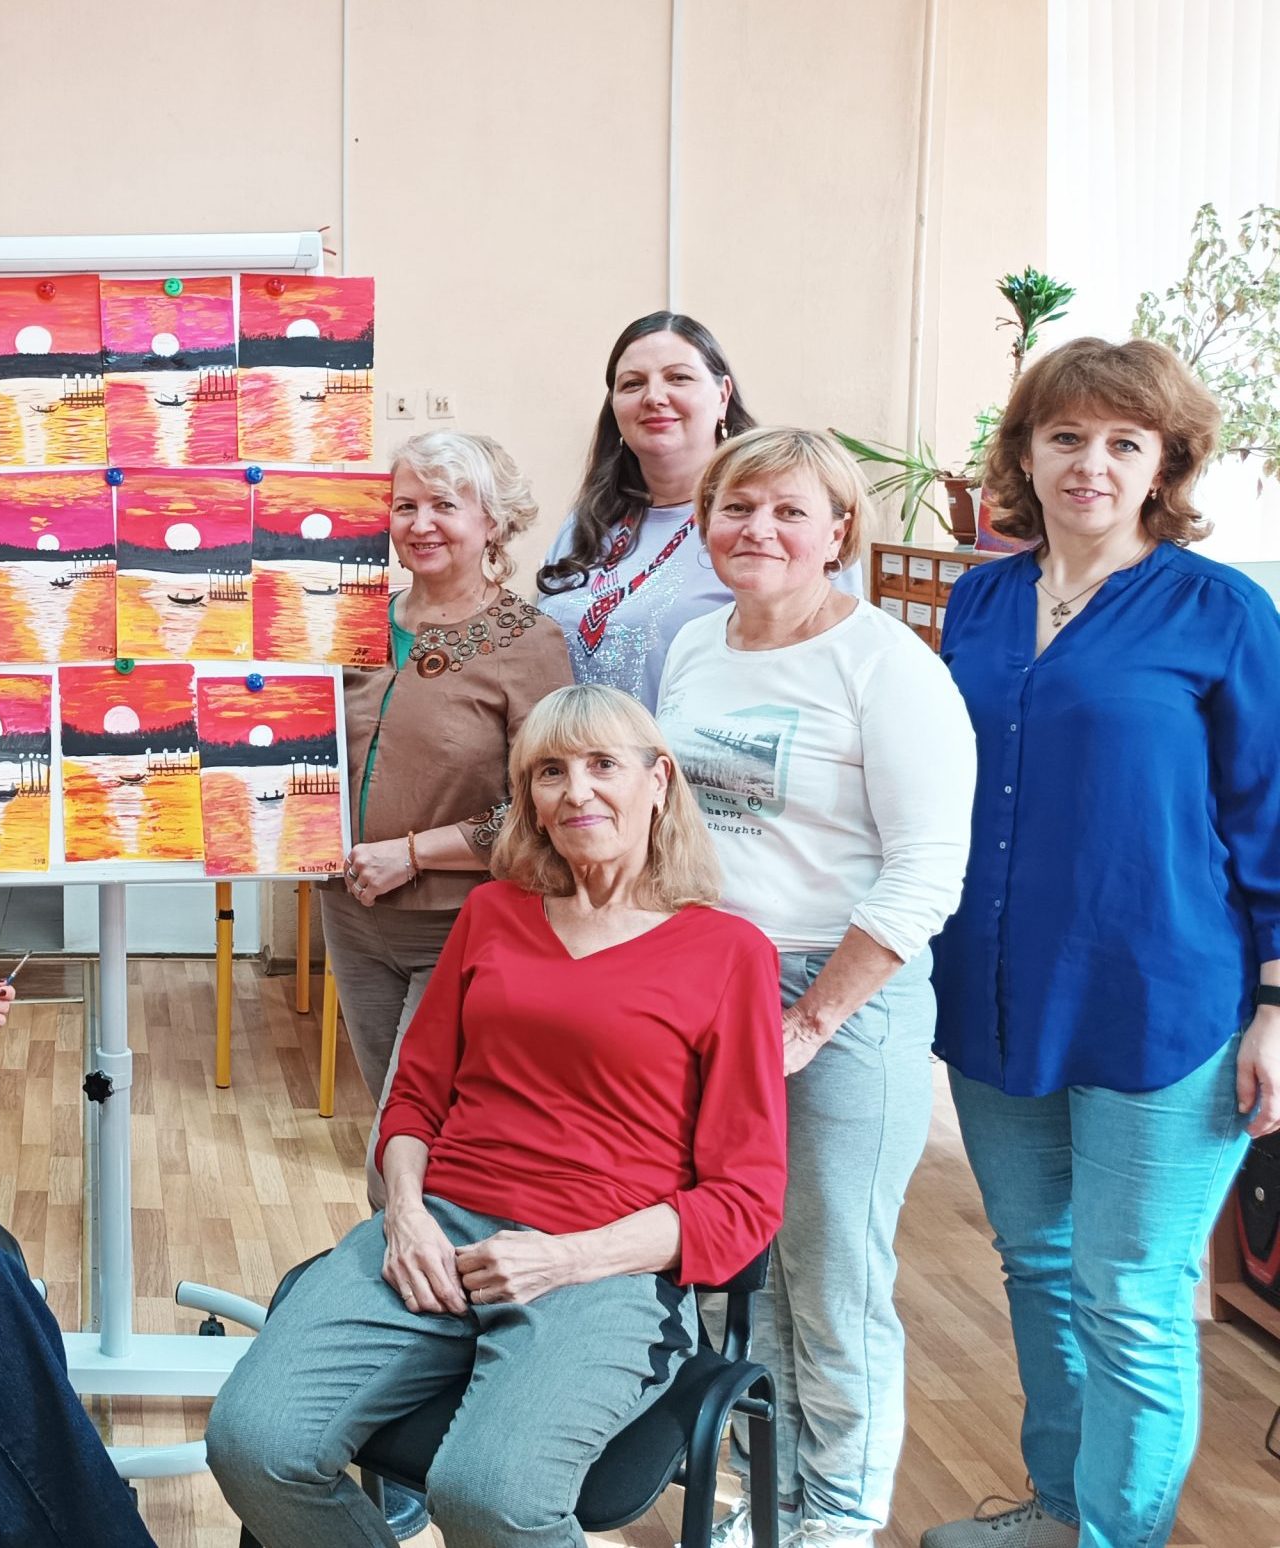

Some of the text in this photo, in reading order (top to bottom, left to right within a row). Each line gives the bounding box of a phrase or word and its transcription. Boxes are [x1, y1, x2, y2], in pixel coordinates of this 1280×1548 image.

[705, 793, 738, 805] think
[707, 807, 742, 819] happy
[707, 823, 762, 835] thoughts
